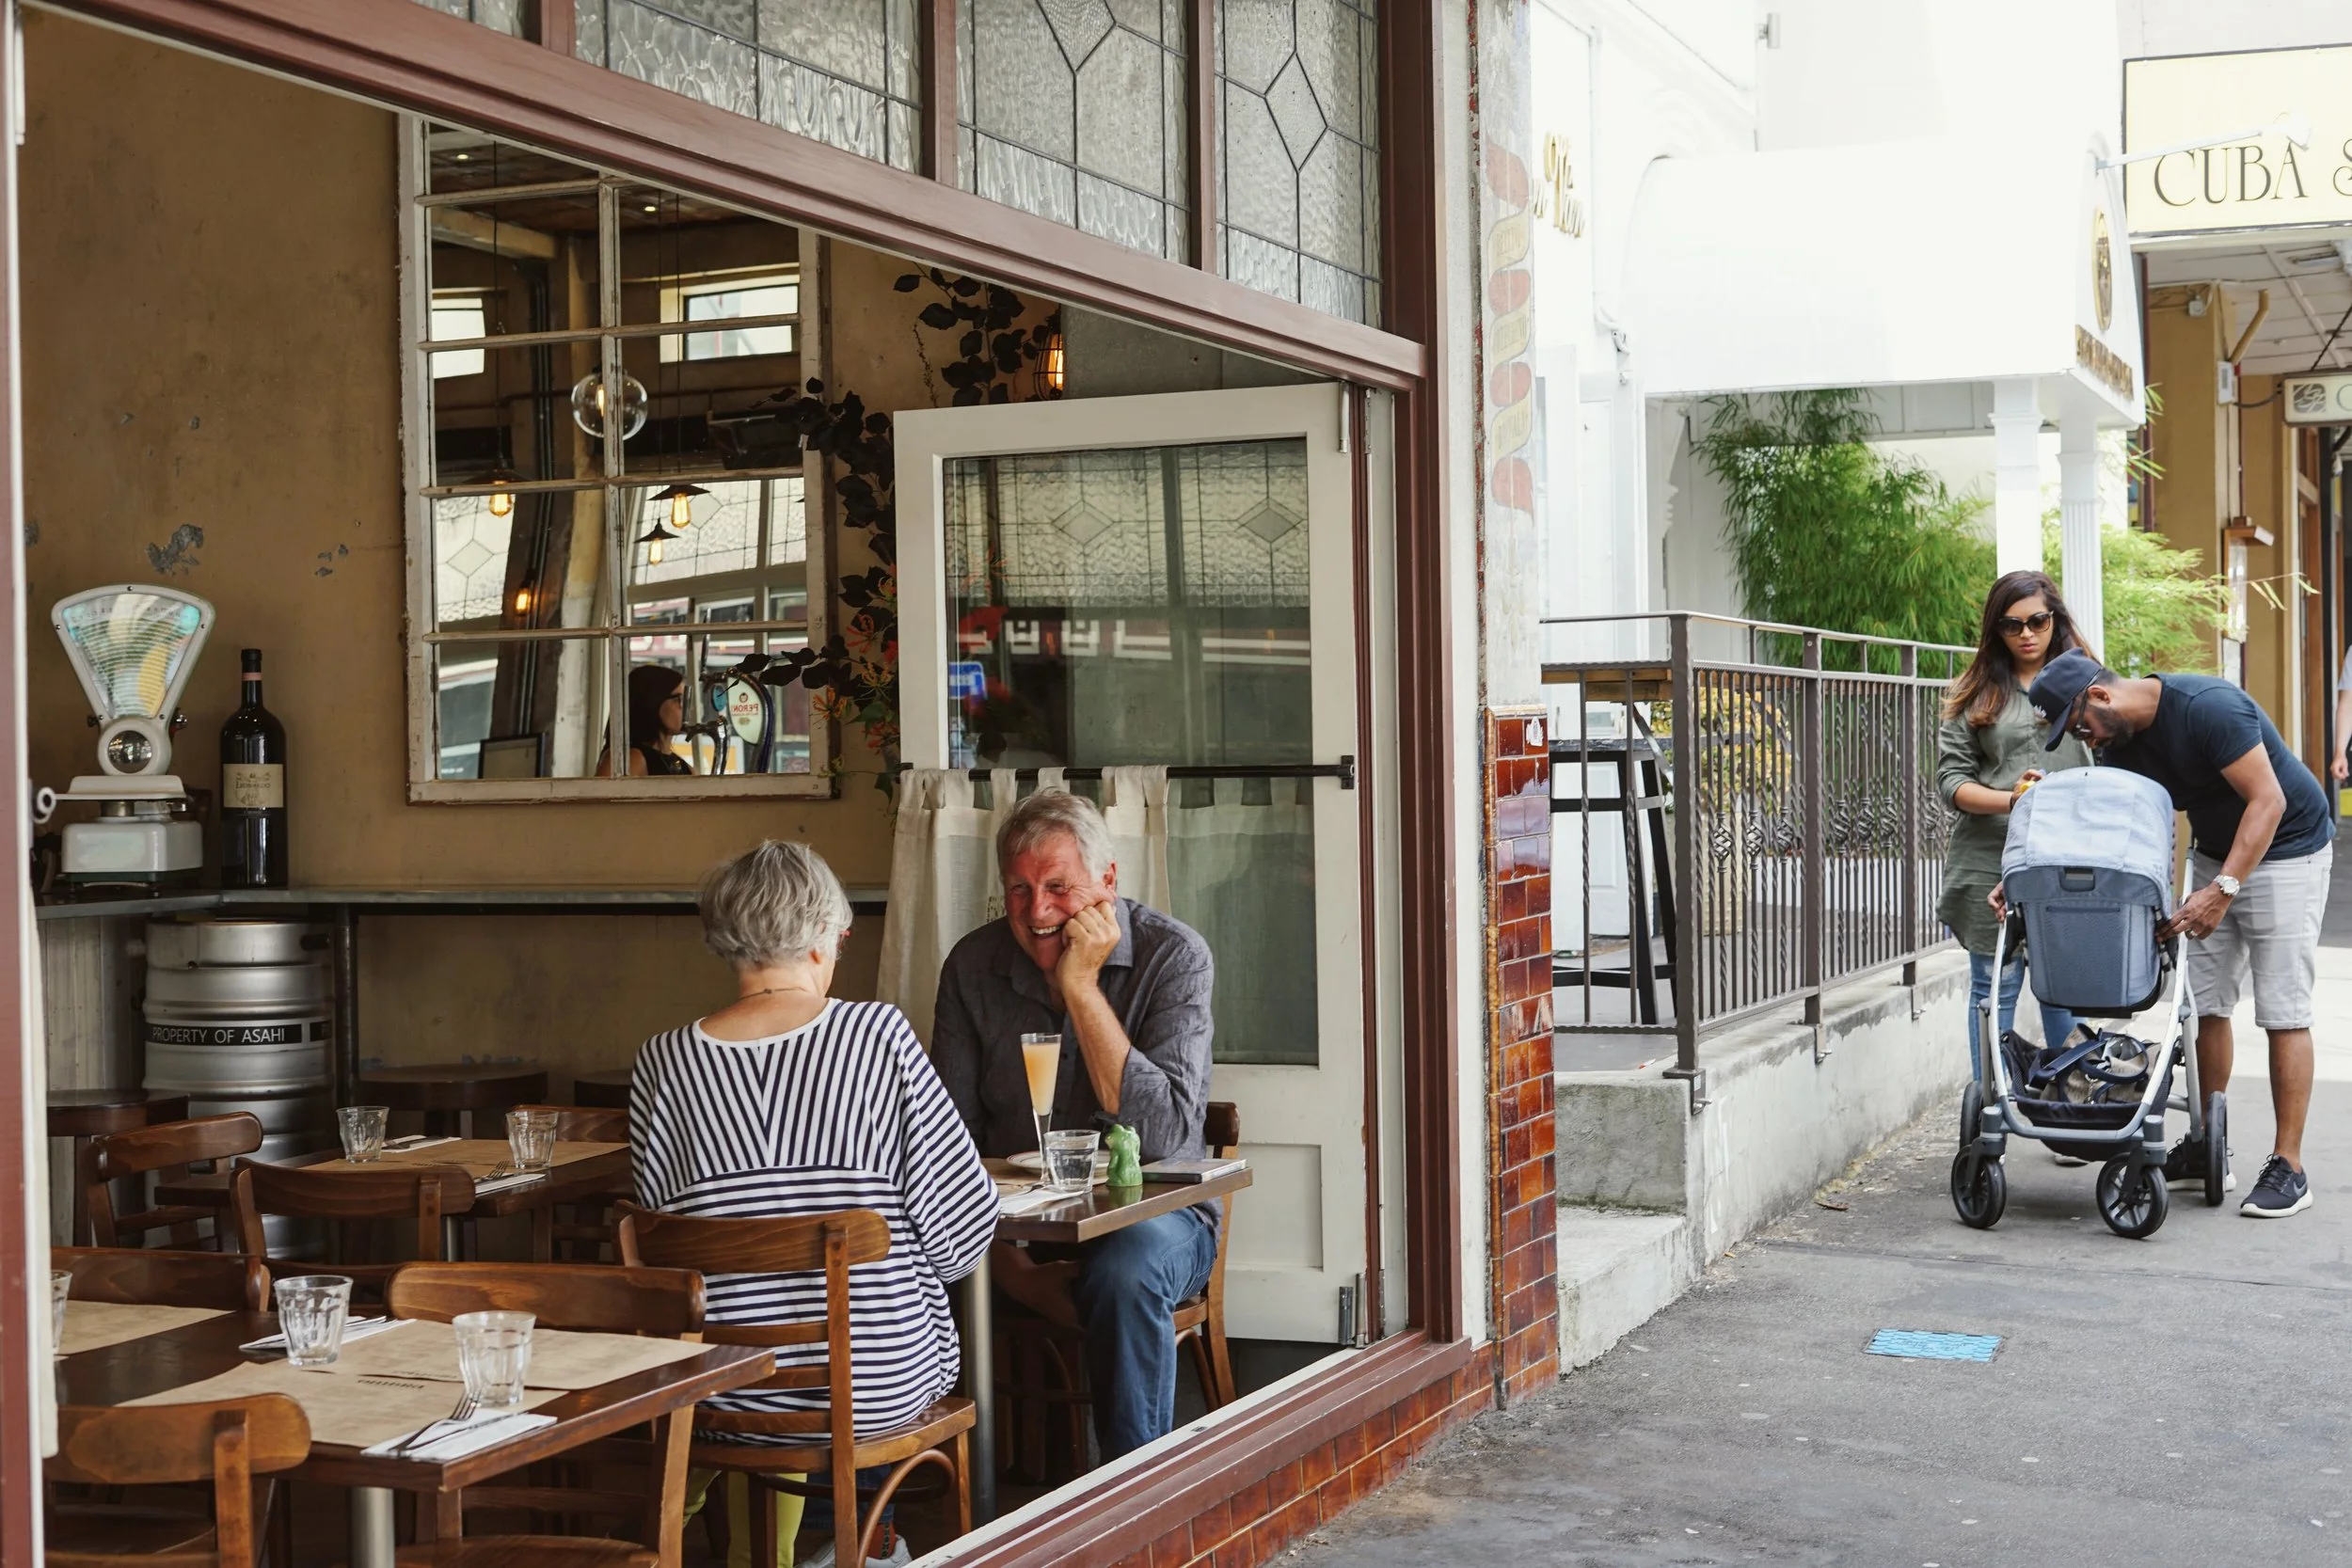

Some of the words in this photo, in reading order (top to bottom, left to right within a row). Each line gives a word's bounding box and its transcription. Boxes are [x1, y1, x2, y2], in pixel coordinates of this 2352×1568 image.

[2153, 140, 2309, 207] CUBA
[152, 1026, 208, 1043] PROPERTY
[215, 1029, 235, 1043] OF
[242, 1028, 285, 1043] ASAHI
